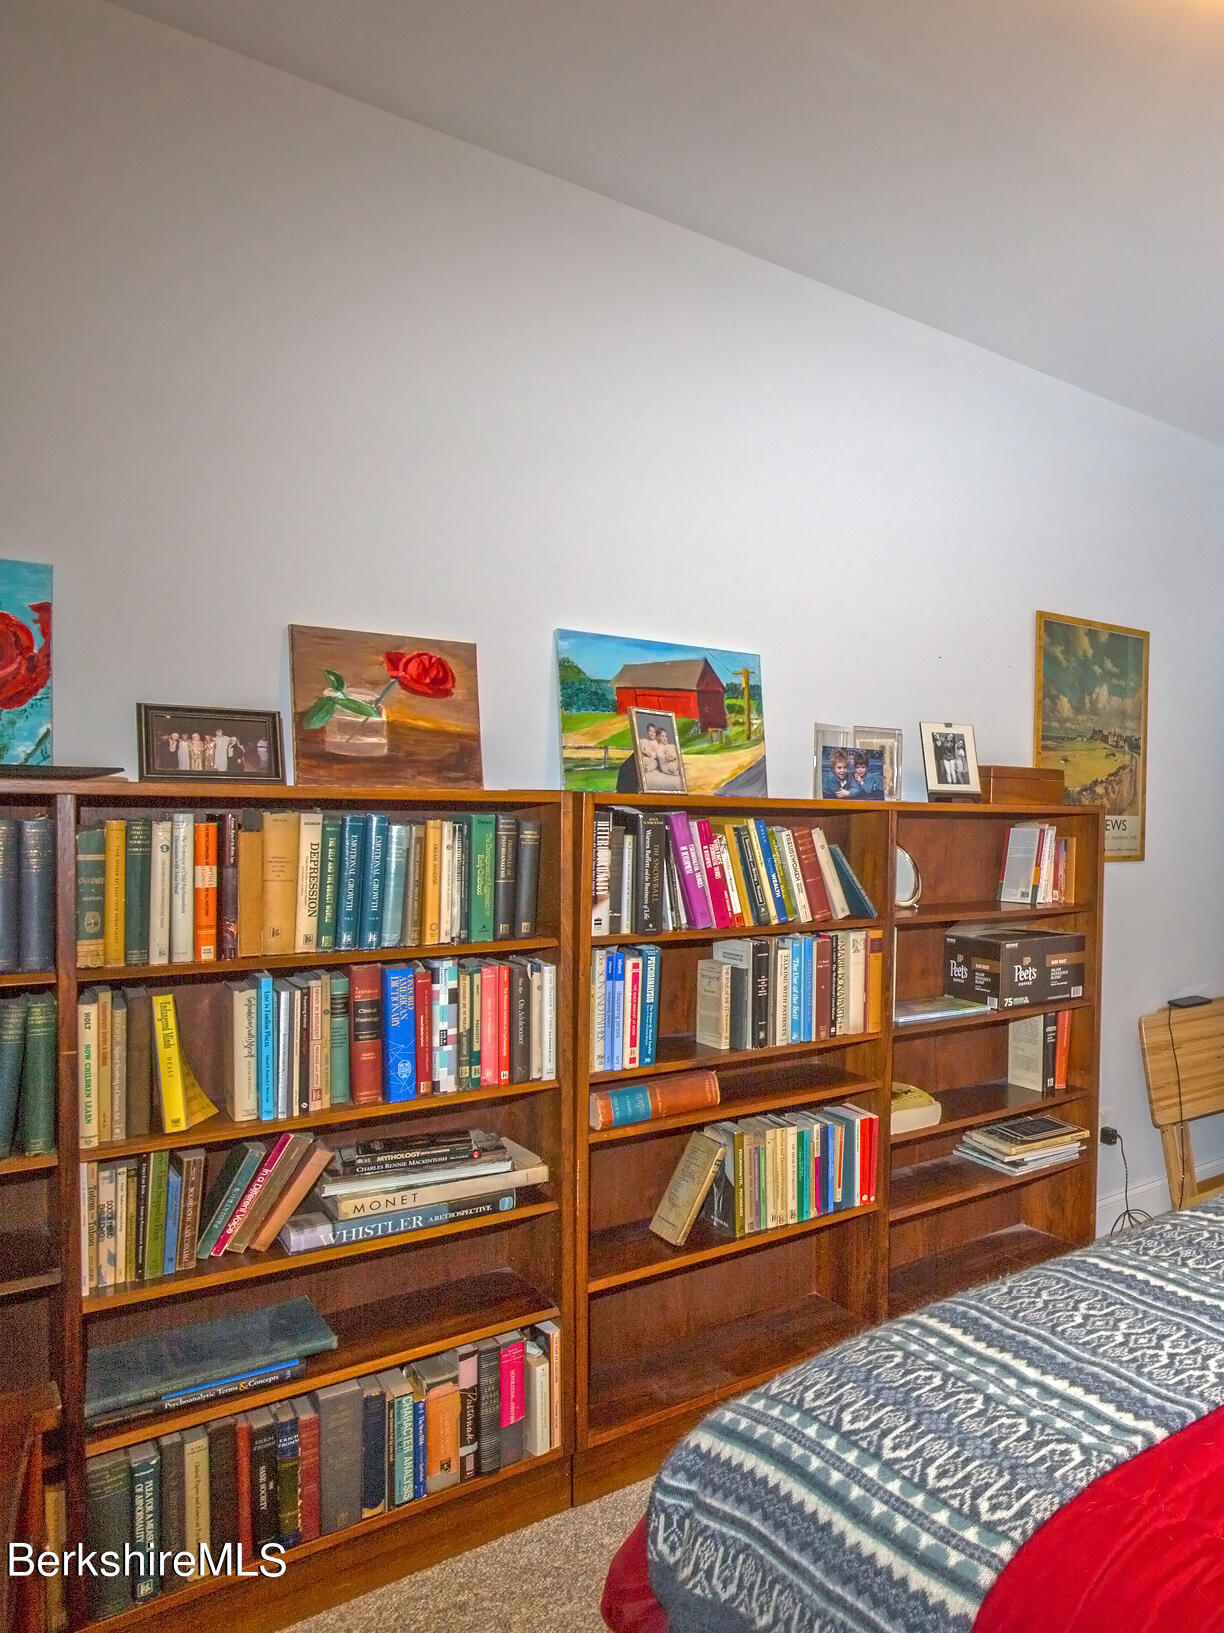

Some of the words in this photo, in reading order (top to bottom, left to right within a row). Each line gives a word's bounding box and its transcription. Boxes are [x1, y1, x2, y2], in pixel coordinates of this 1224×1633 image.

[328, 848, 336, 860] SELF
[347, 835, 358, 876] EMOTIONAL
[373, 835, 383, 876] EMOTIONAL
[308, 842, 320, 918] DEPRESSION
[346, 878, 355, 911] GROWTH
[371, 879, 380, 911] GROWTH
[652, 859, 660, 902] SNOWBALL
[771, 873, 781, 898] WEALTH
[837, 943, 846, 970] MARIE
[950, 960, 969, 979] Peet's
[646, 956, 656, 1003] PSYCHOANALYSIS
[1014, 965, 1037, 983] Peet's
[390, 976, 400, 1027] DICTIONARY
[399, 975, 408, 1019] AMERICAN
[518, 999, 526, 1010] On
[836, 973, 845, 1021] BONAPARTE
[1004, 997, 1013, 1007] 75
[157, 1000, 173, 1031] Endangered
[163, 1032, 175, 1049] Minds
[84, 1100, 92, 1124] LEARN
[356, 1164, 384, 1173] CHARLES
[384, 1160, 407, 1169] RENNIE
[408, 1156, 448, 1166] MACKINTOSH
[376, 1151, 421, 1162] MYTHOLOGY
[88, 1185, 97, 1211] Totem
[213, 1187, 241, 1229] PEDIATRICS
[238, 1183, 264, 1214] Different
[353, 1192, 419, 1215] MONET
[88, 1221, 97, 1247] Taboo
[226, 1212, 245, 1234] Voice
[320, 1215, 423, 1247] WHISTLER
[434, 1204, 493, 1222] RETROSPECTIVE
[164, 1387, 216, 1409] Psychoanalytic
[216, 1384, 238, 1395] Terms
[238, 1381, 249, 1391] &
[248, 1373, 279, 1388] Concepts
[403, 1396, 413, 1451] CHARACTER
[461, 1390, 477, 1445] Pasternak
[135, 1483, 143, 1492] OF
[145, 1480, 154, 1498] PLEA
[403, 1456, 413, 1500] ANALYSIS
[135, 1494, 144, 1544] ABNORMALITY
